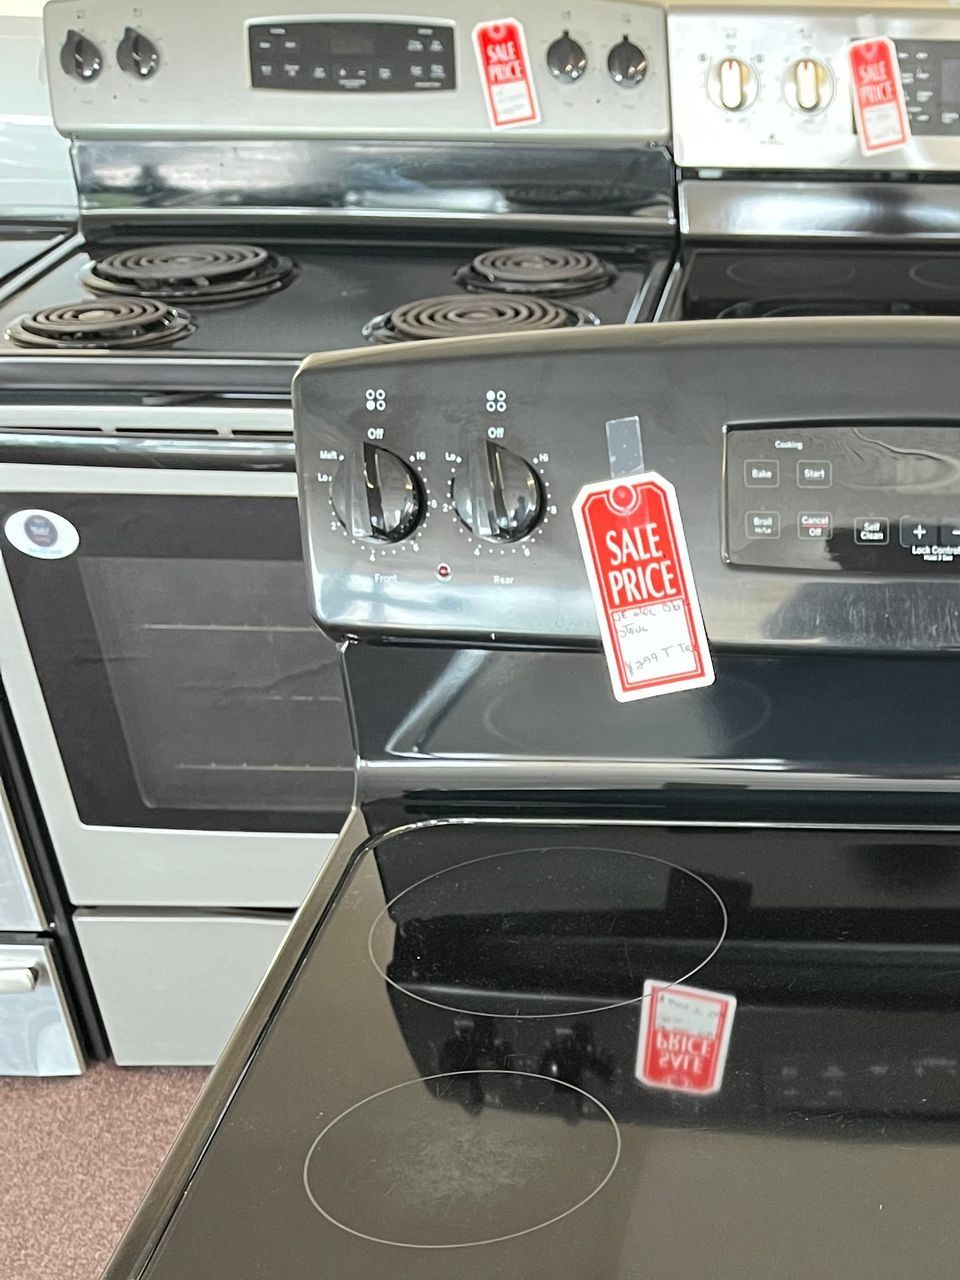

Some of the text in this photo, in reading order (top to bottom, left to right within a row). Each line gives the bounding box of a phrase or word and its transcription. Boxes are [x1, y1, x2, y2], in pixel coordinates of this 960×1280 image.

[487, 41, 516, 62] SALE
[368, 429, 384, 439] Off
[488, 427, 504, 438] Off
[775, 440, 803, 450] Cooking
[320, 451, 337, 460] Melt
[417, 452, 426, 460] Hi
[446, 453, 456, 461] Lo
[540, 454, 548, 462] Hi
[318, 473, 328, 481] Lo
[752, 469, 772, 478] Bake
[804, 469, 825, 478] Start
[443, 504, 448, 512] 2
[753, 517, 772, 526] Broil
[801, 516, 829, 524] Cancel
[331, 522, 336, 530] 2
[864, 522, 880, 531] Self
[809, 528, 822, 536] Off
[860, 531, 884, 540] Clean
[606, 523, 663, 566] SALE
[912, 546, 931, 554] Lock
[375, 574, 397, 583] Front
[494, 575, 514, 584] Rear
[609, 560, 677, 605] PRICE
